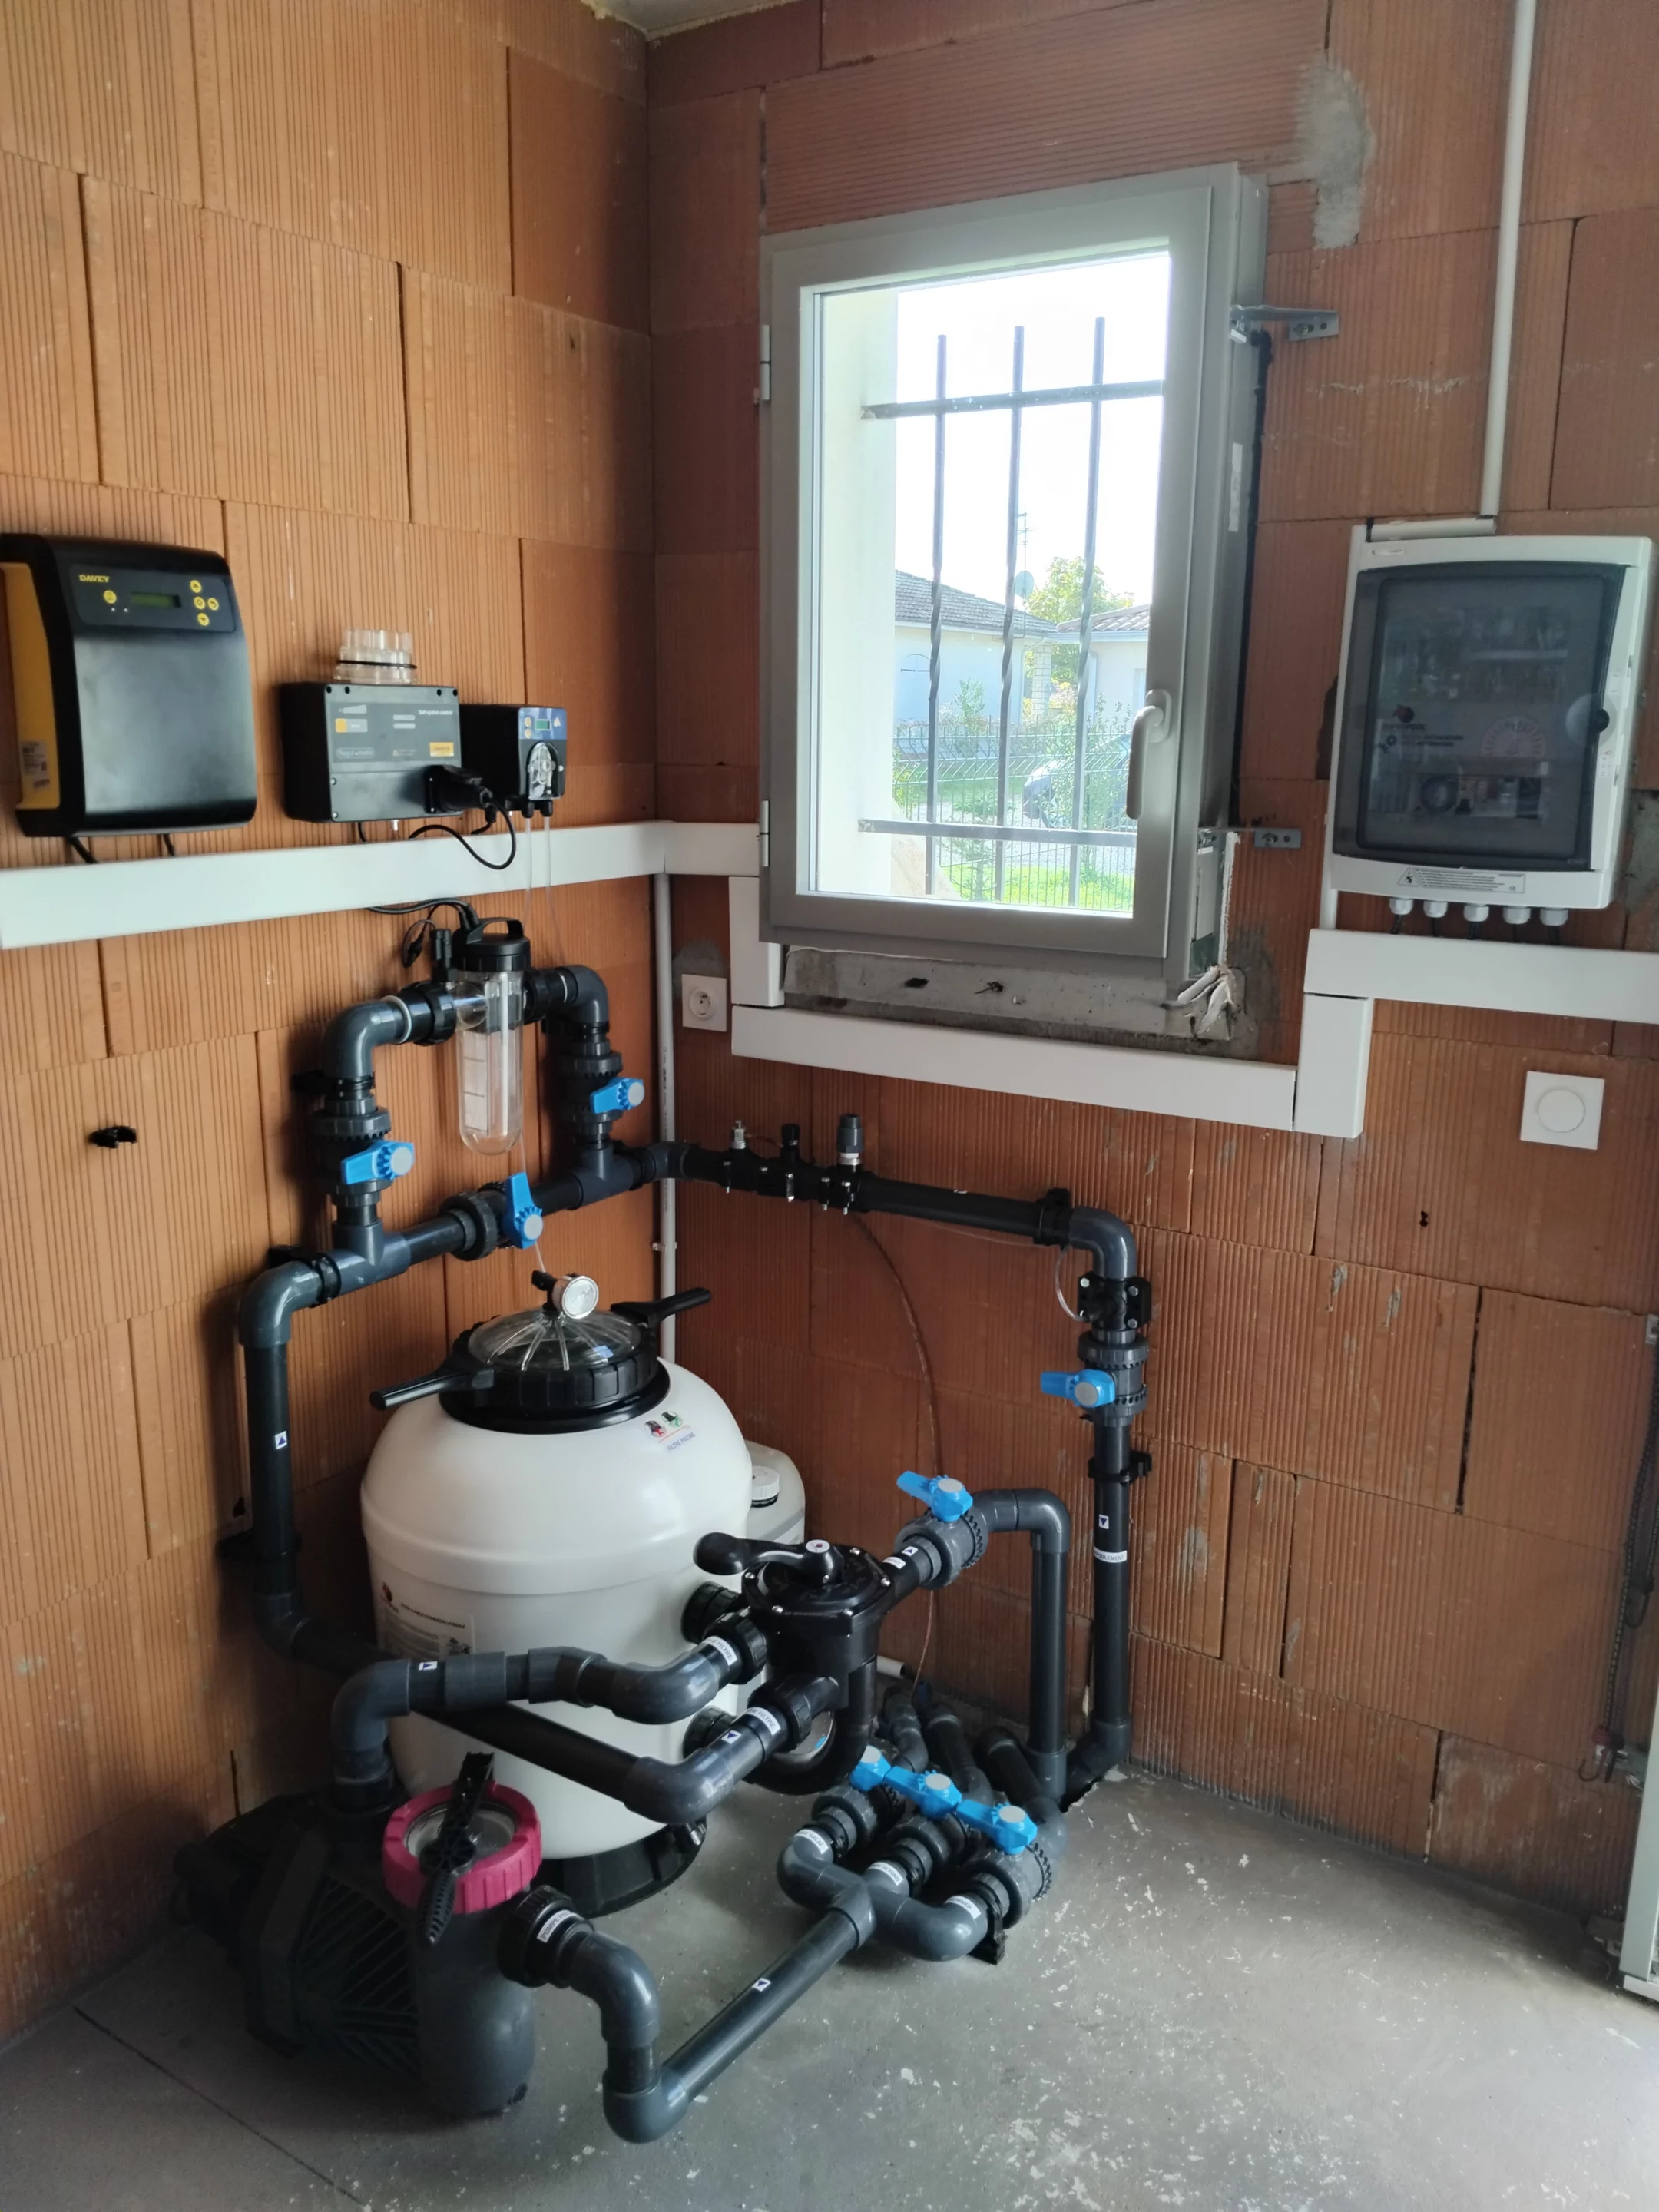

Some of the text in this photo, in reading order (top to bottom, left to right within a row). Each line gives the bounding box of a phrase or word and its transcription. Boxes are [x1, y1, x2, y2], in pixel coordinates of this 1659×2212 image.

[79, 575, 109, 583] DAVEY
[717, 1641, 732, 1658] FILTRE
[757, 1711, 776, 1727] FILTRE
[541, 1917, 560, 1939] POMPE
